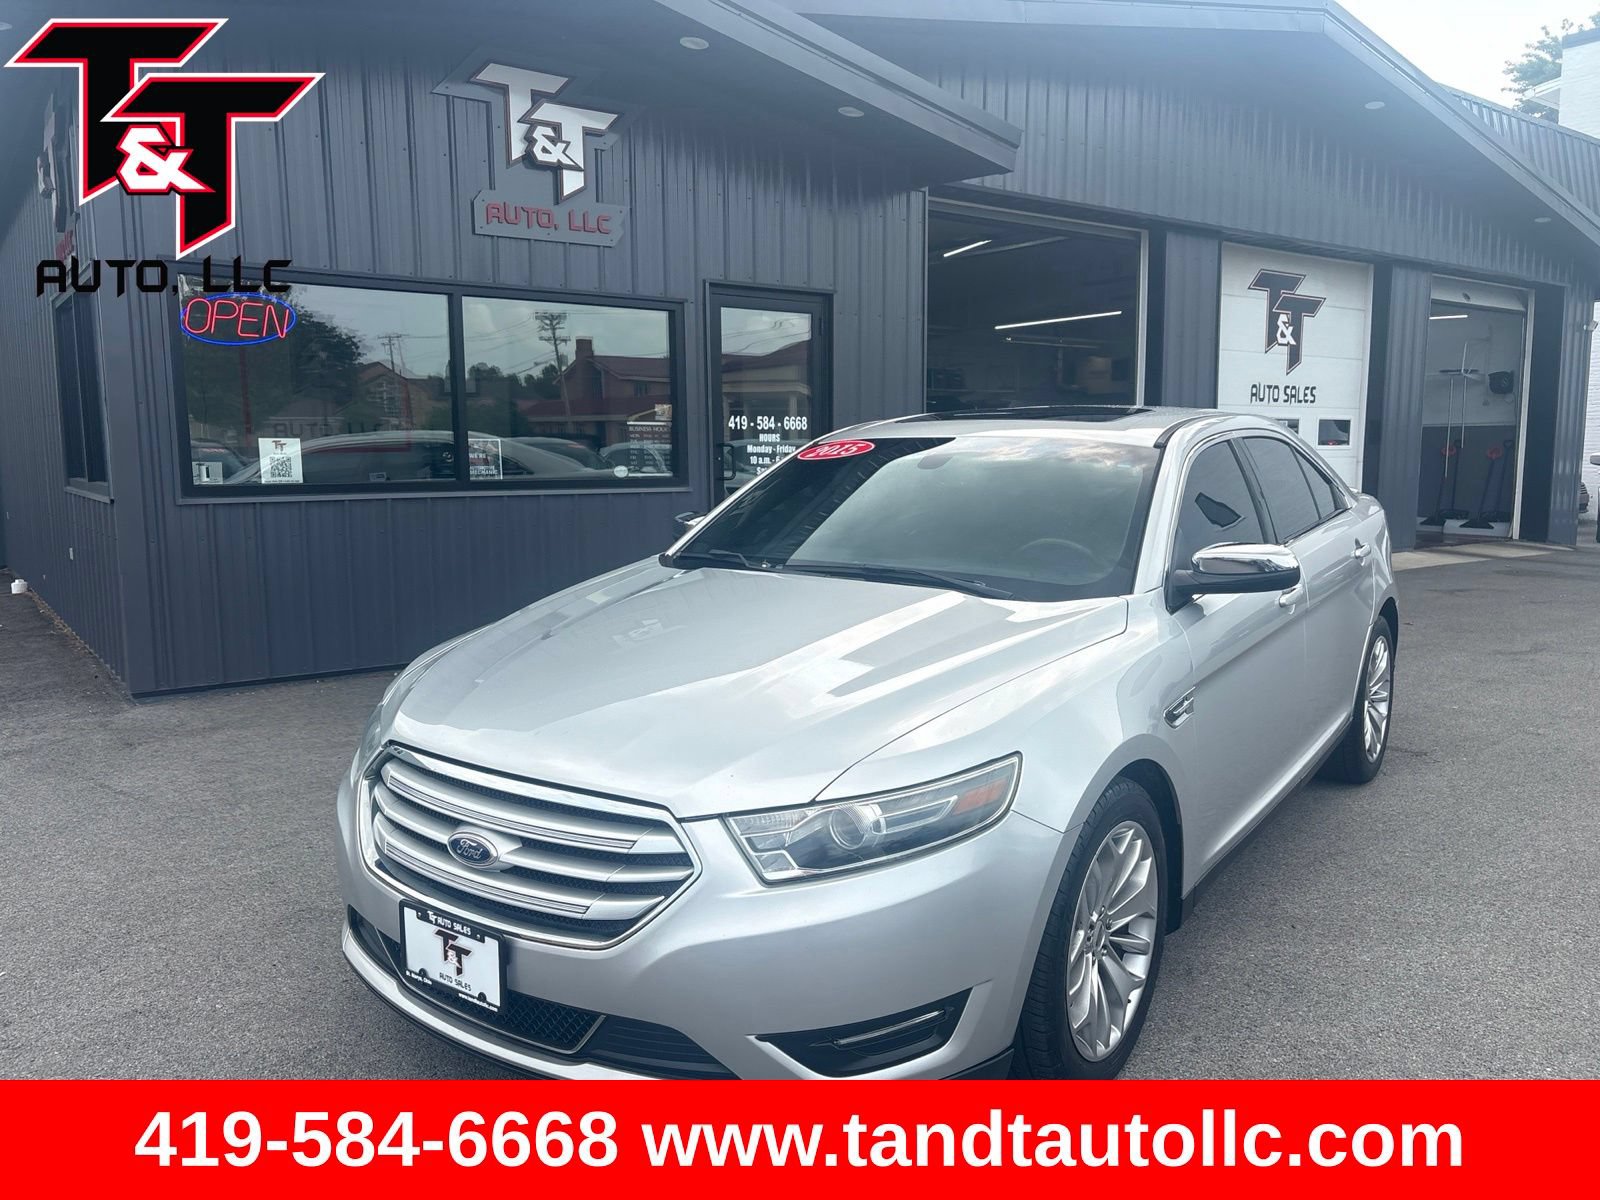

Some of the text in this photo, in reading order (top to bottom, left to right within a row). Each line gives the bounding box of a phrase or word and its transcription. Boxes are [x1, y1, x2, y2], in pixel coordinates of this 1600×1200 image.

[469, 61, 621, 202] T&T
[486, 201, 612, 234] AUTO, LLC
[185, 297, 289, 338] OPEN
[1248, 268, 1326, 376] T&T
[1250, 382, 1316, 404] AUTO SALES
[728, 415, 748, 430] 419
[756, 416, 775, 430] 584
[783, 416, 808, 430] 6668
[759, 433, 781, 442] HOURS
[746, 444, 772, 454] Monday
[776, 445, 796, 454] Friday
[805, 443, 866, 458] 2015
[750, 456, 757, 465] 10
[456, 838, 483, 859] Ford
[437, 916, 452, 928] AUTO
[453, 922, 471, 935] SALES
[439, 972, 453, 984] AUTO
[454, 979, 472, 992] SALES
